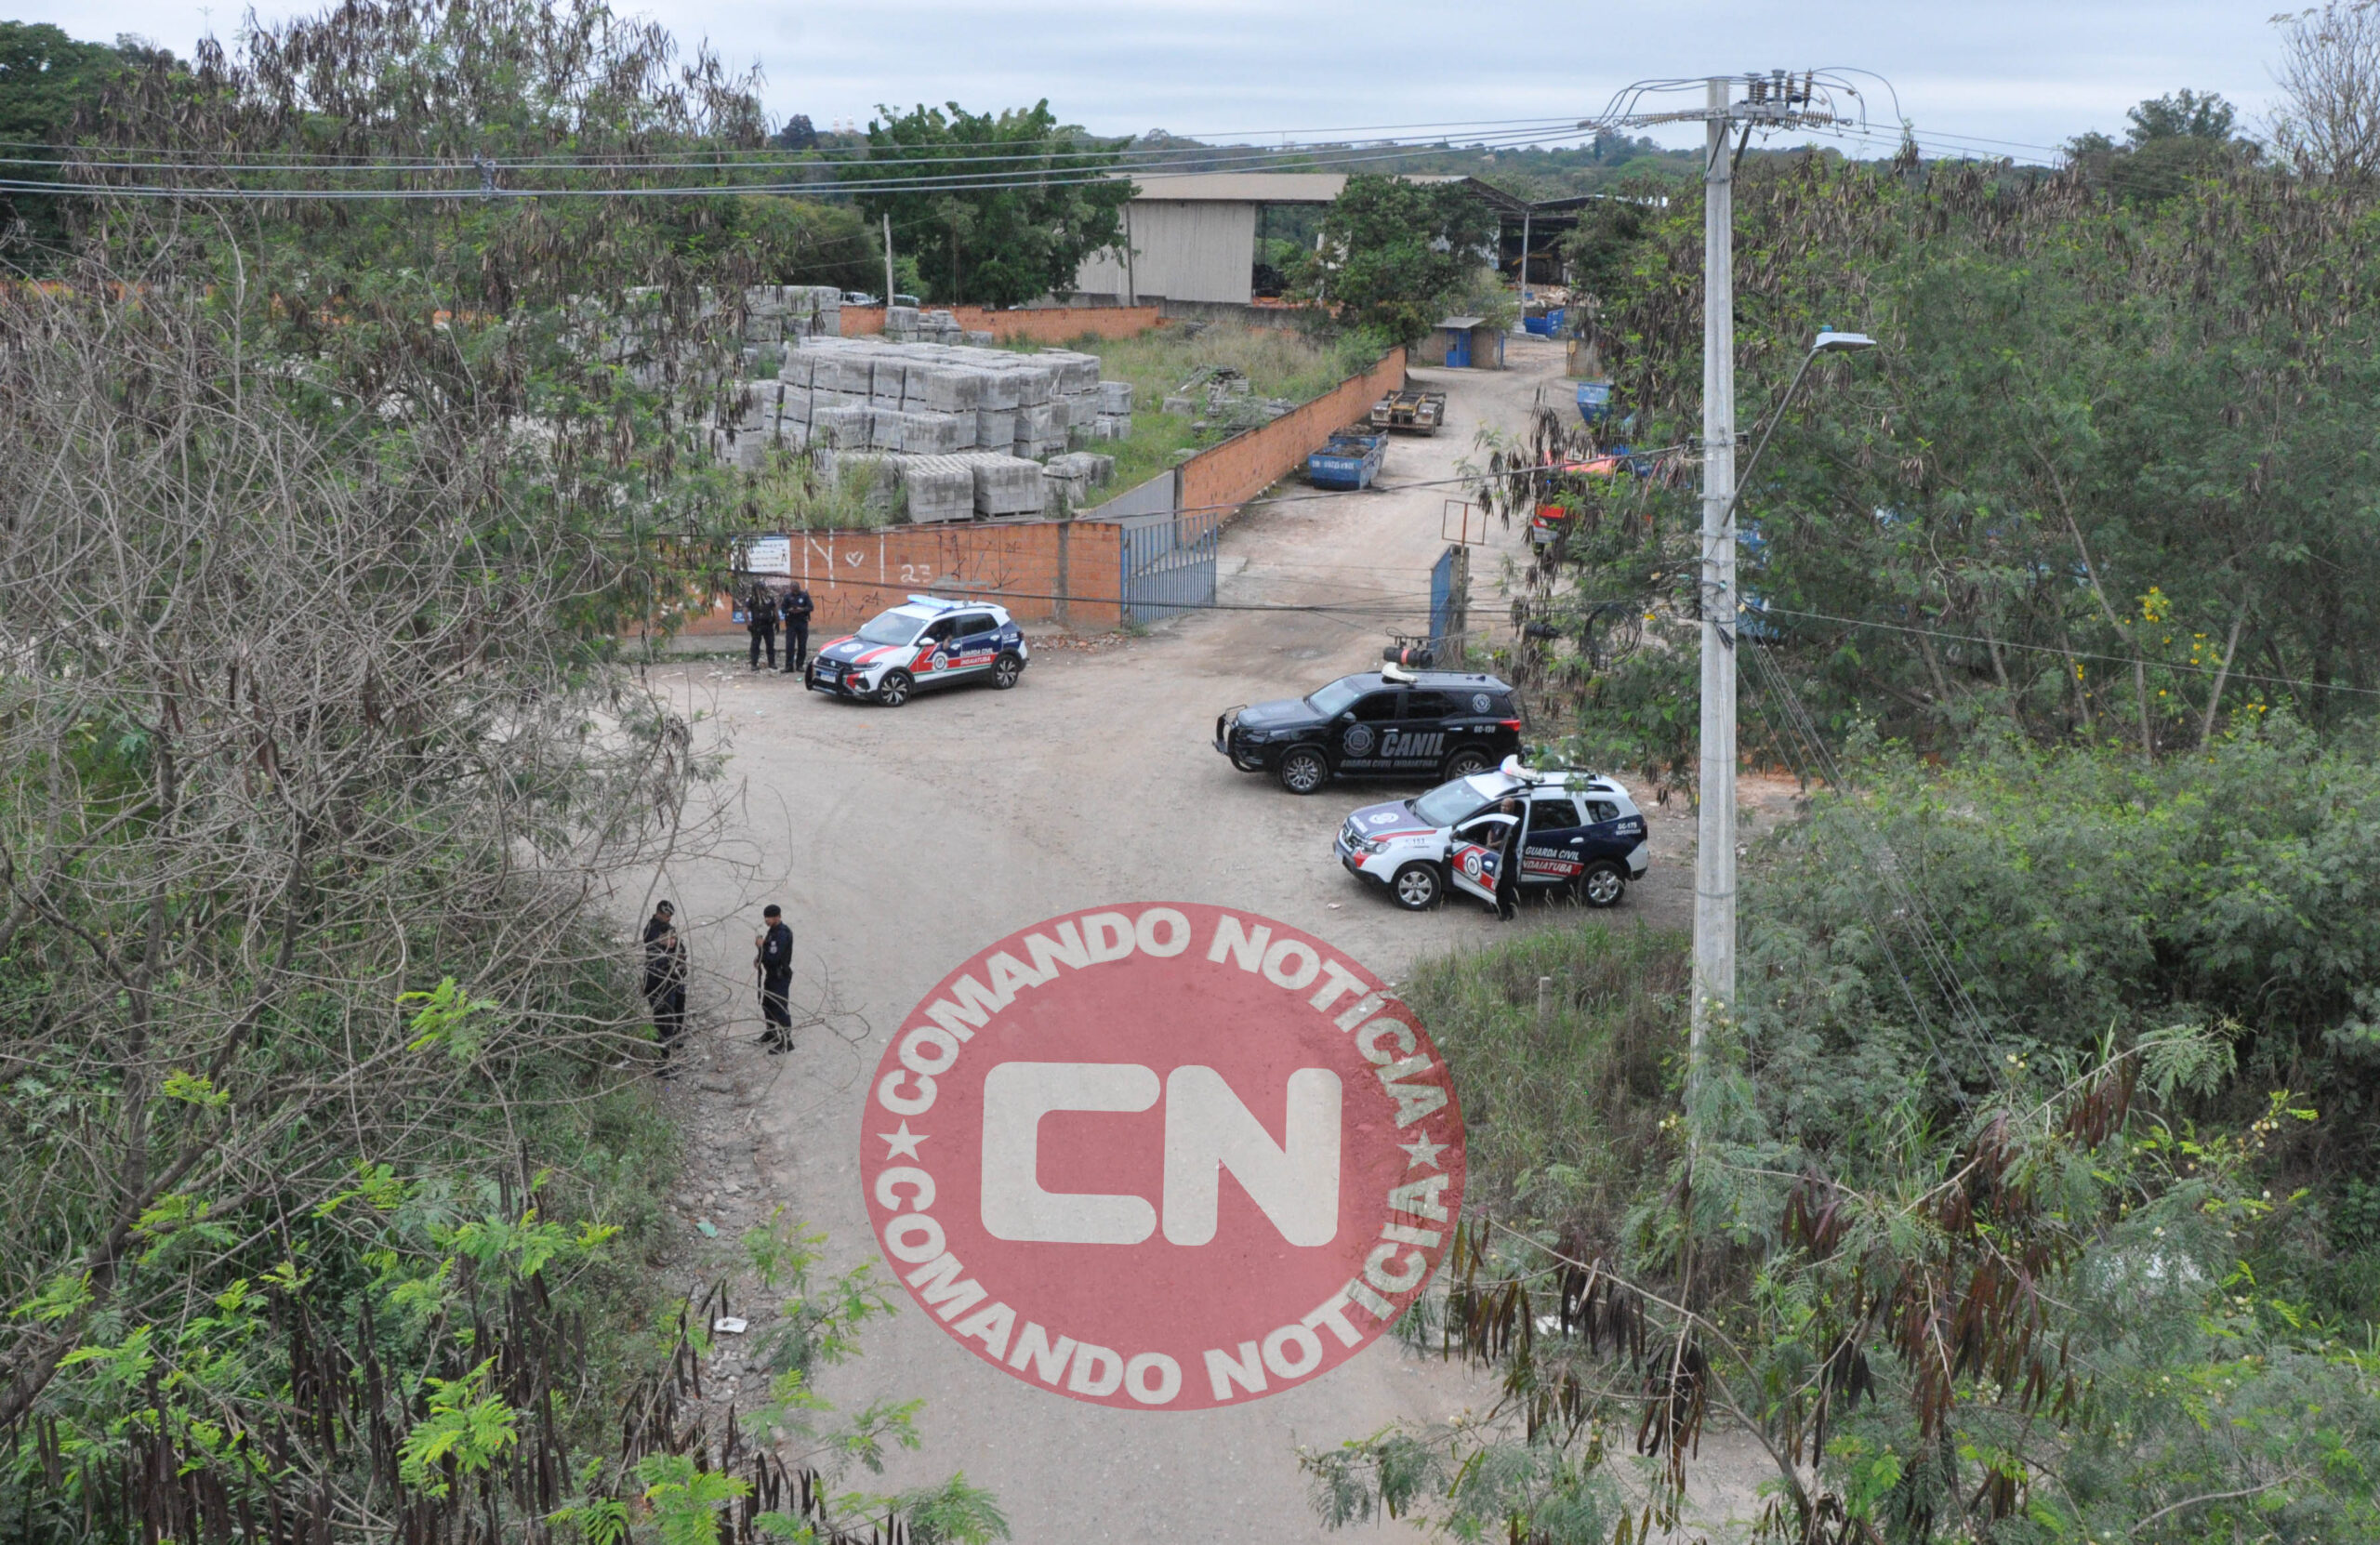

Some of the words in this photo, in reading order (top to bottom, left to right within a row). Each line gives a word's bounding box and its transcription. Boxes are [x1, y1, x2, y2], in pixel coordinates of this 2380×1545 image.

[1380, 733, 1445, 757] CANIL
[1340, 759, 1371, 768] GUARDA
[1525, 846, 1556, 857] GUARDA
[1558, 850, 1580, 860] CIVIL
